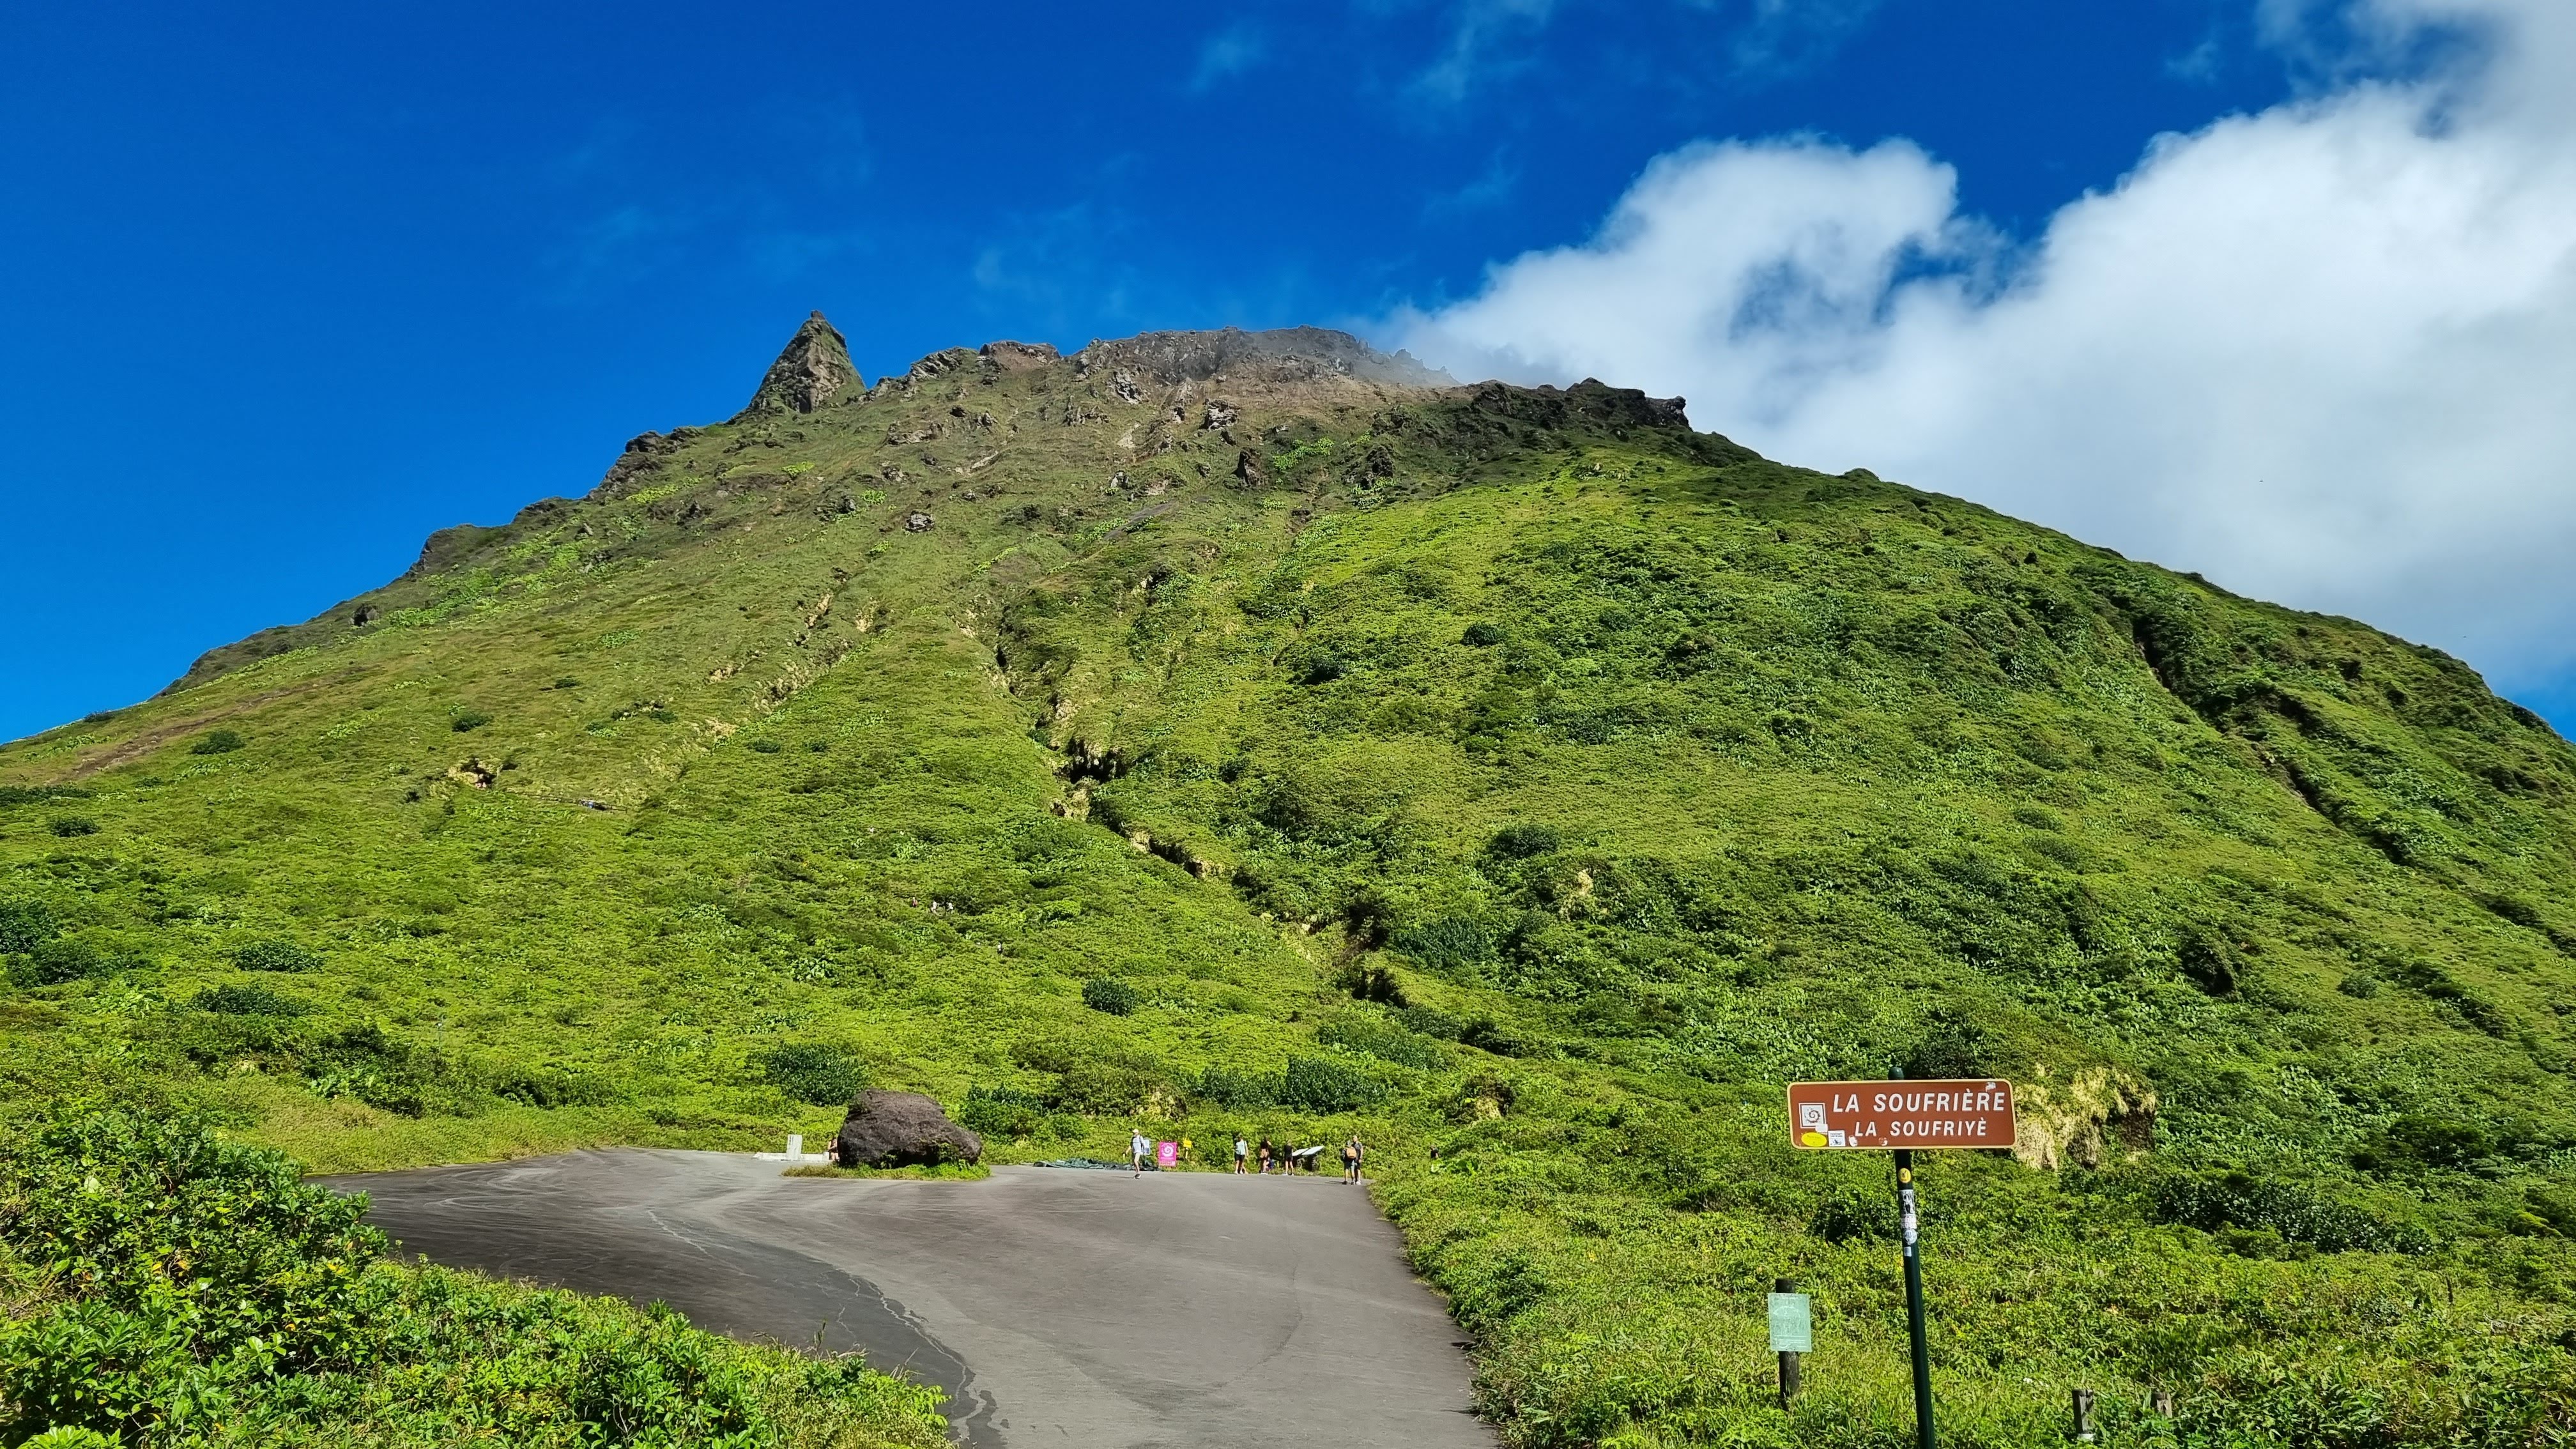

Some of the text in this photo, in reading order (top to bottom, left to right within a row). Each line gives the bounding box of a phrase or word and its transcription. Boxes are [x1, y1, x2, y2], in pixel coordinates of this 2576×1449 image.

[1833, 1089, 2005, 1112] LA SOUFRIÈRE
[1855, 1117, 1986, 1137] LA SOUFRIYÈ
